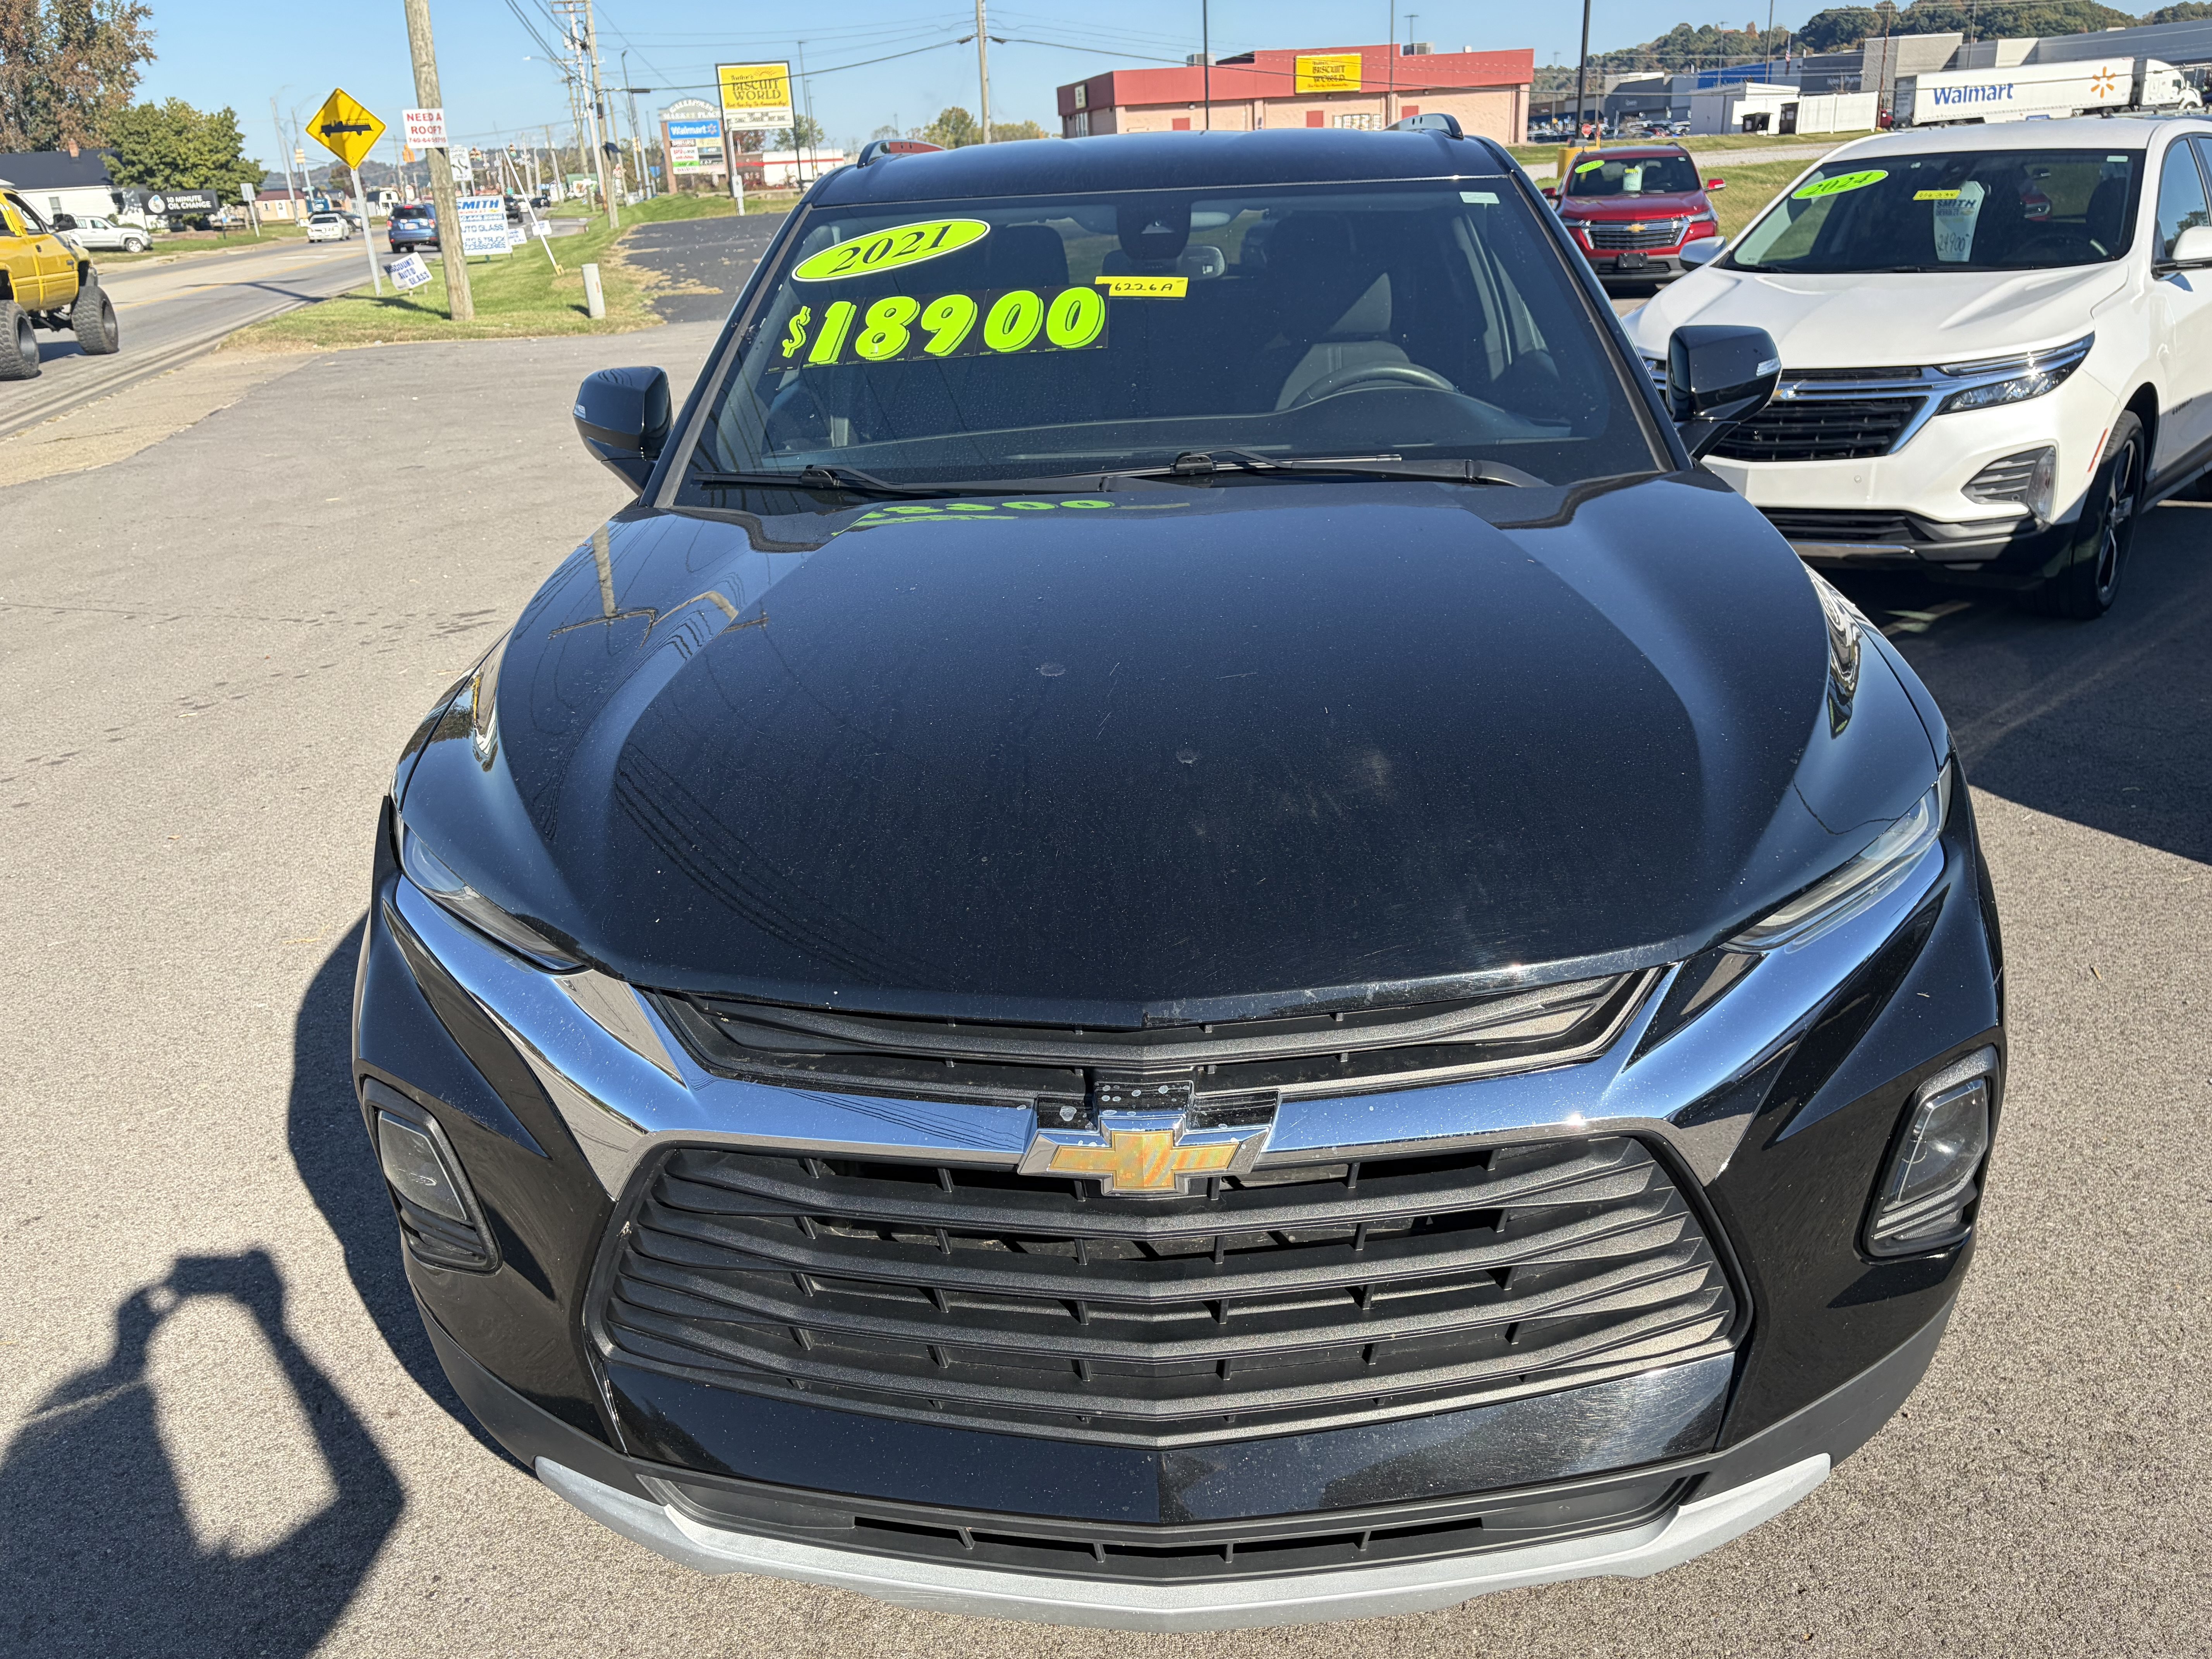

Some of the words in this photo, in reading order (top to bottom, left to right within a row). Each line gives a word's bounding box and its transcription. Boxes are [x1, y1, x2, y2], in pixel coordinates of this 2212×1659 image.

[1312, 65, 1345, 74] BISCUIT
[732, 79, 780, 91] BISCUIT
[733, 89, 781, 101] WORLD
[1932, 82, 2013, 105] Walmart
[407, 112, 433, 122] NEED
[436, 112, 442, 121] A
[411, 125, 441, 134] ROOF?
[670, 125, 707, 136] Walmart
[175, 195, 203, 203] MINUTE
[181, 201, 212, 210] CHANGE
[457, 199, 499, 210] SMITH
[461, 225, 477, 233] UTO
[478, 223, 504, 232] GLASS
[827, 223, 953, 275] 2021
[1115, 283, 1173, 291] 6226A
[781, 287, 1106, 365] $18900
